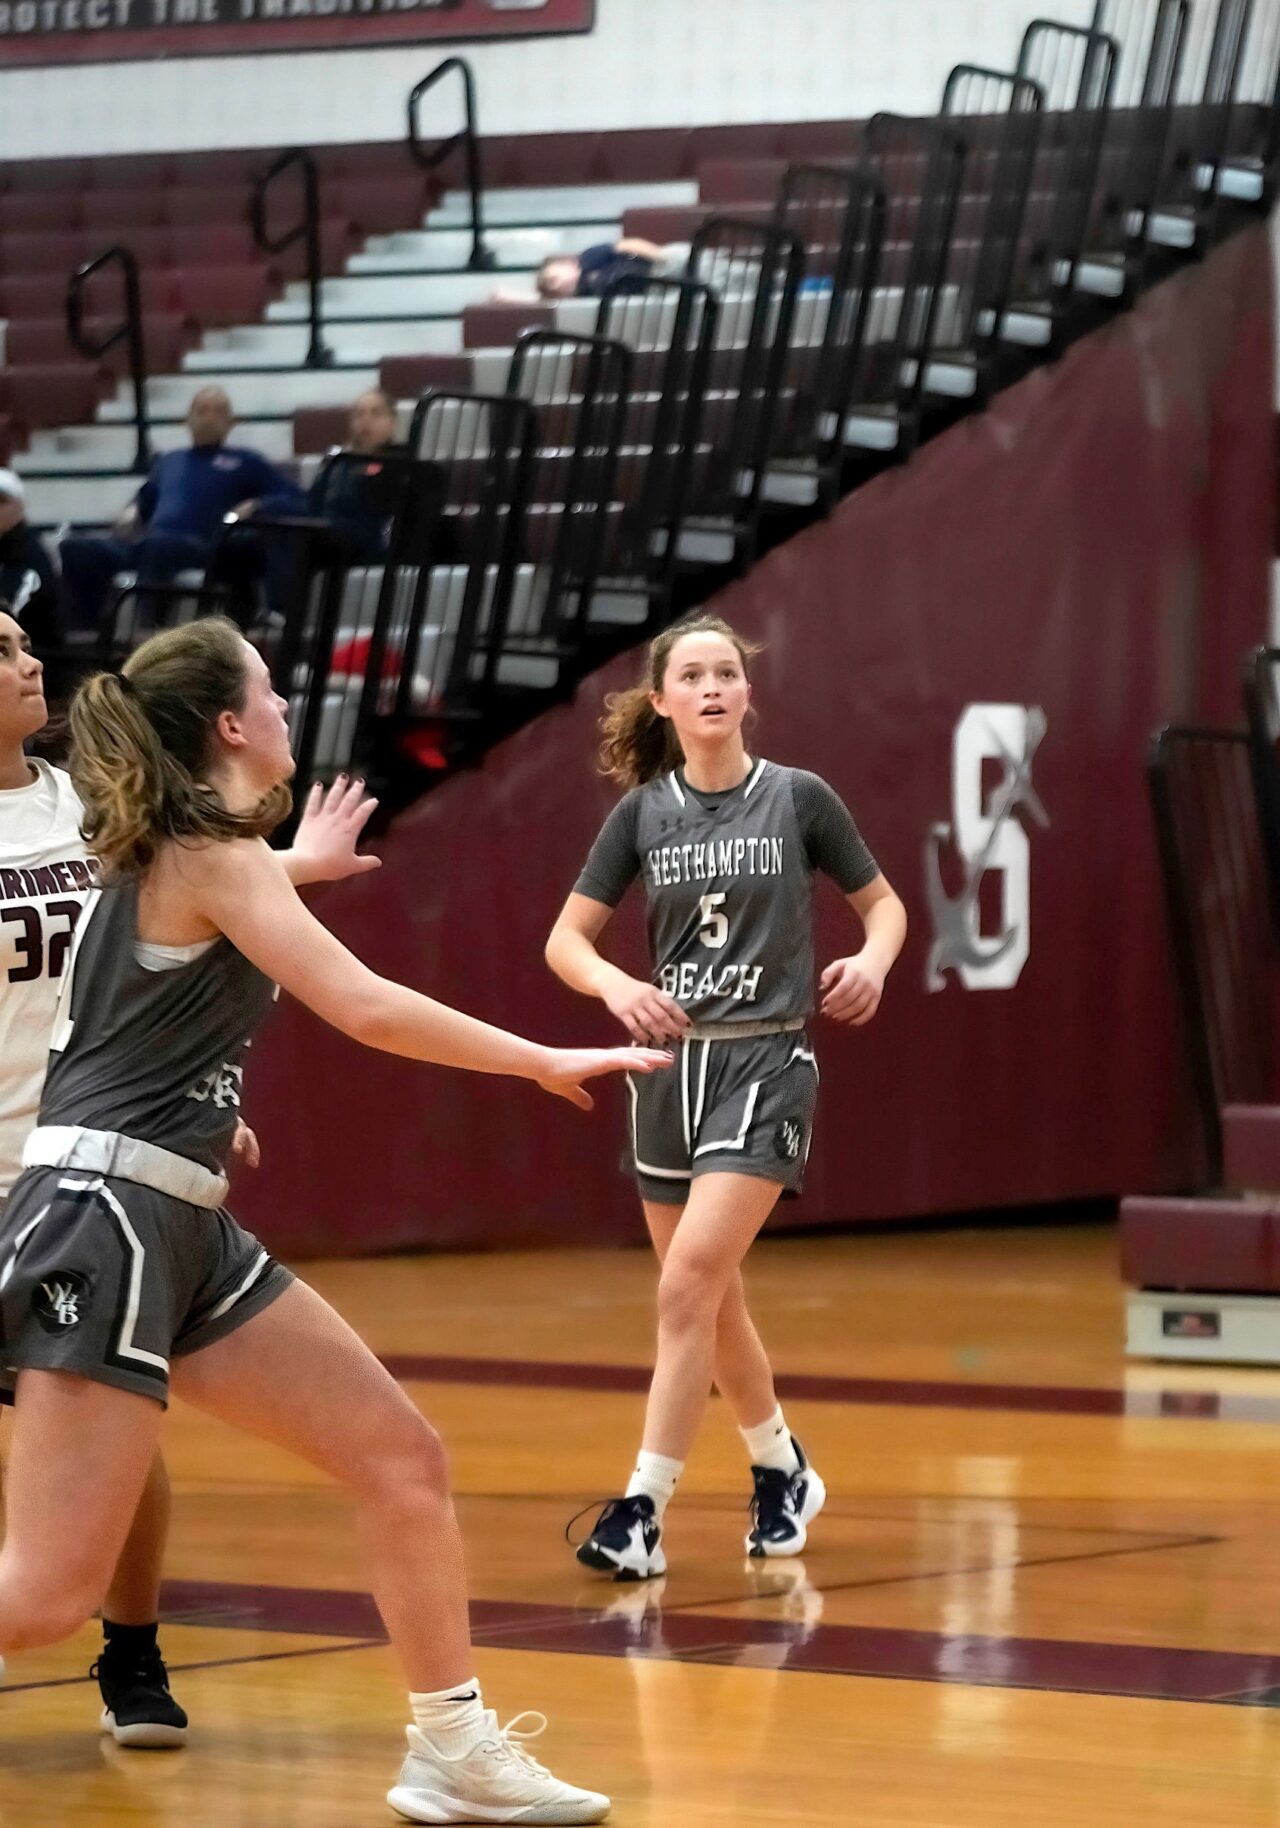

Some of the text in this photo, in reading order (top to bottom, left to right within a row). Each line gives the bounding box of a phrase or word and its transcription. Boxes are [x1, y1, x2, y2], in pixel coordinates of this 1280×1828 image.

[649, 837, 784, 886] WESTHAMPTON
[0, 899, 83, 983] 32
[699, 892, 729, 949] 5
[660, 961, 765, 1002] BEACH
